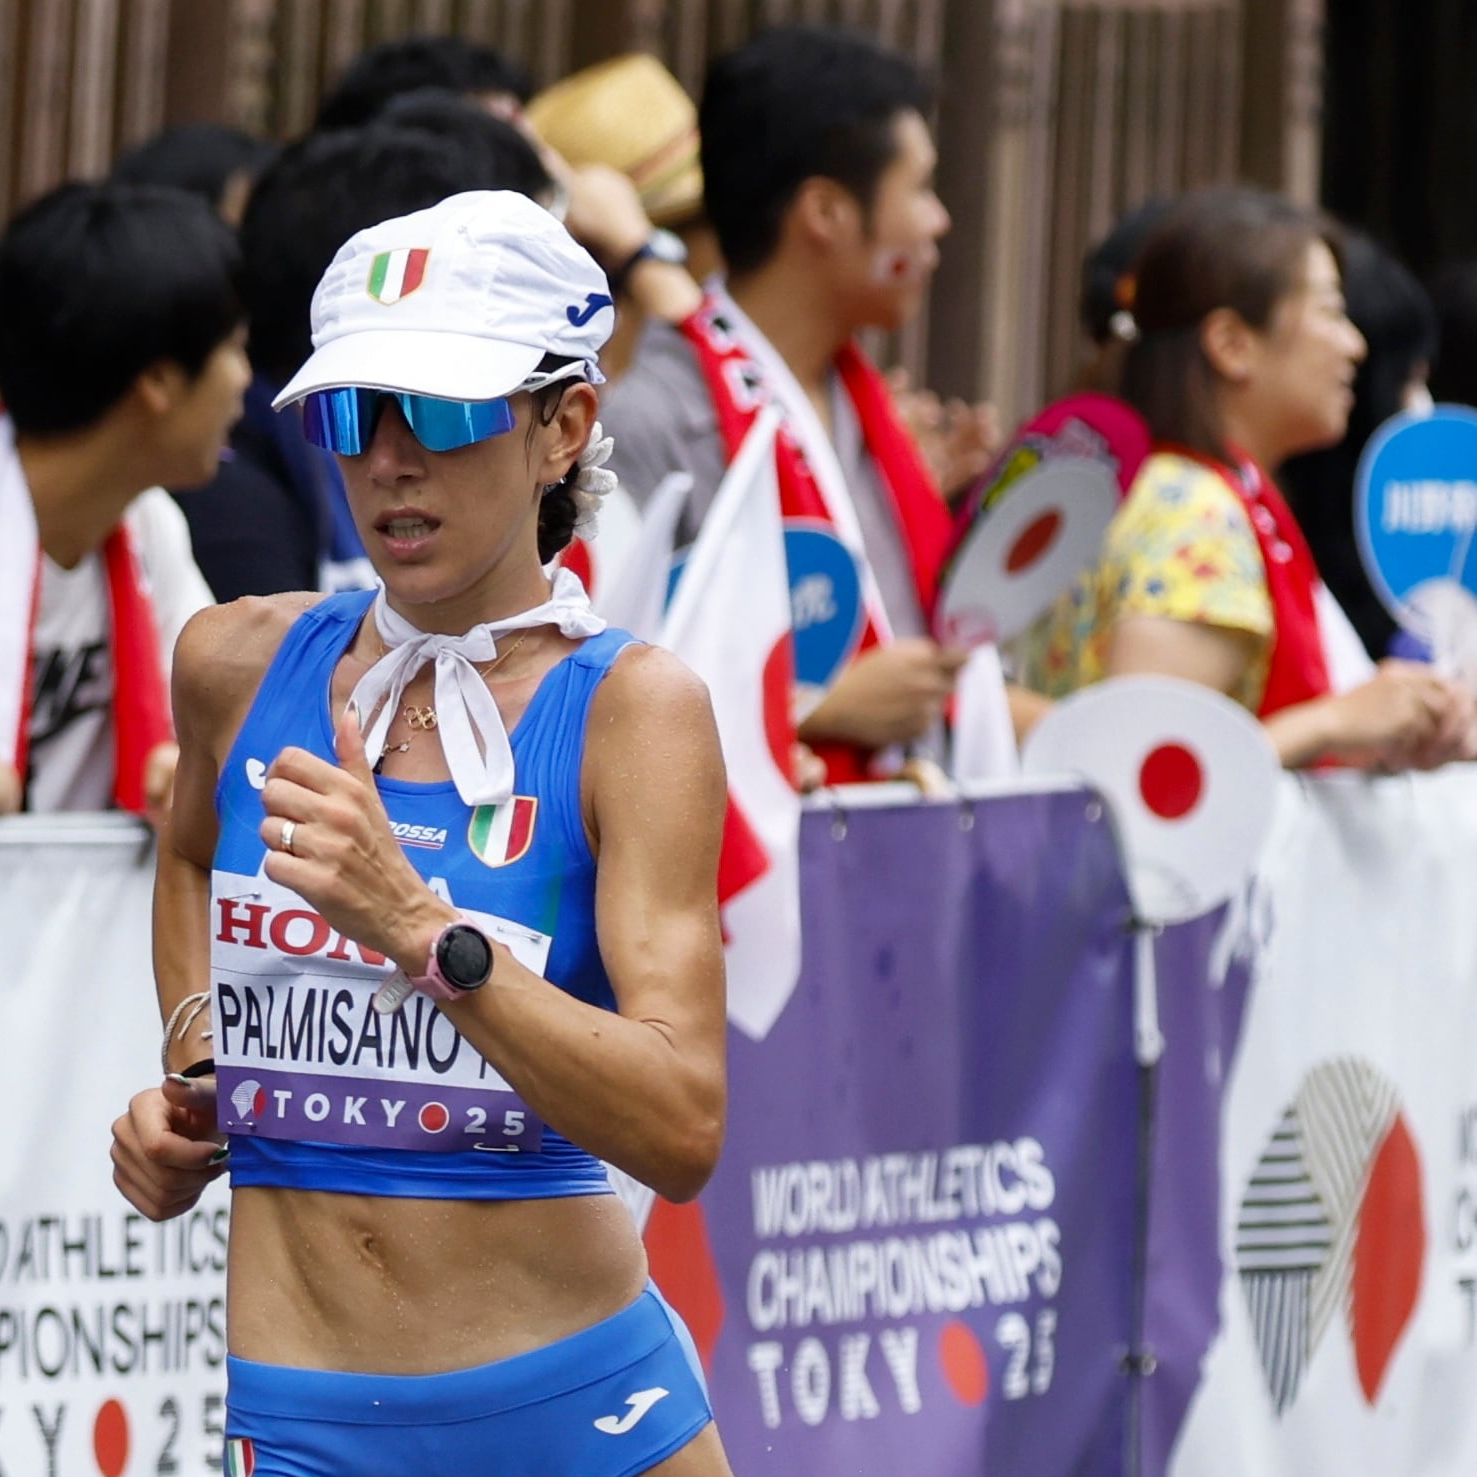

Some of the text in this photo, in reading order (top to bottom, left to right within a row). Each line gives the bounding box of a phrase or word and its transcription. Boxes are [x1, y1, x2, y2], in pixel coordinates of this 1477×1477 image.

[217, 983, 463, 1074] PALMISANO
[464, 1106, 526, 1136] 25
[750, 1137, 1056, 1241] WORLD ATHLETICS
[13, 1206, 229, 1283] ATHLETICS
[747, 1217, 1063, 1331] CHAMPIONSHIPS
[156, 1394, 224, 1477] 25
